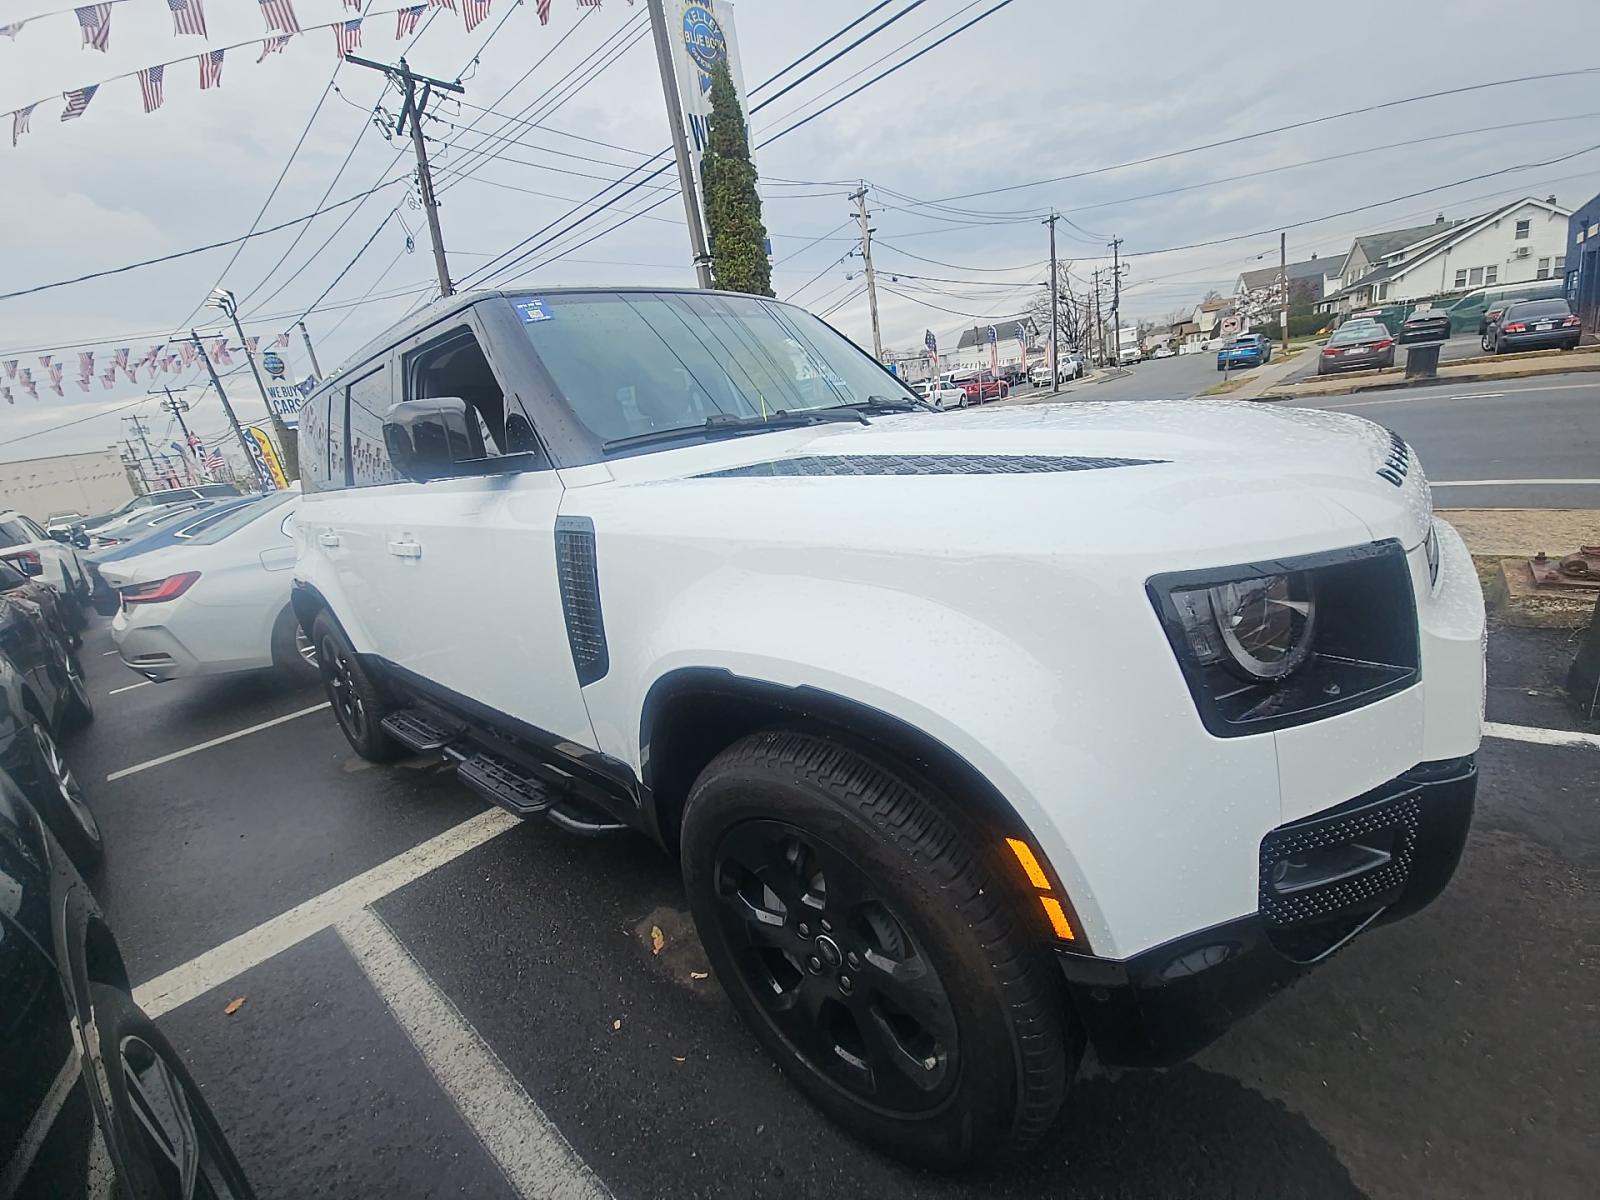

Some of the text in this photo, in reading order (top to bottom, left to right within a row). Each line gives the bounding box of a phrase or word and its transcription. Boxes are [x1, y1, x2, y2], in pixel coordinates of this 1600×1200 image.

[685, 10, 719, 35] KELLEY
[684, 31, 726, 53] BLUE BOOK
[267, 386, 300, 398] WE BUY
[273, 399, 301, 415] CARS
